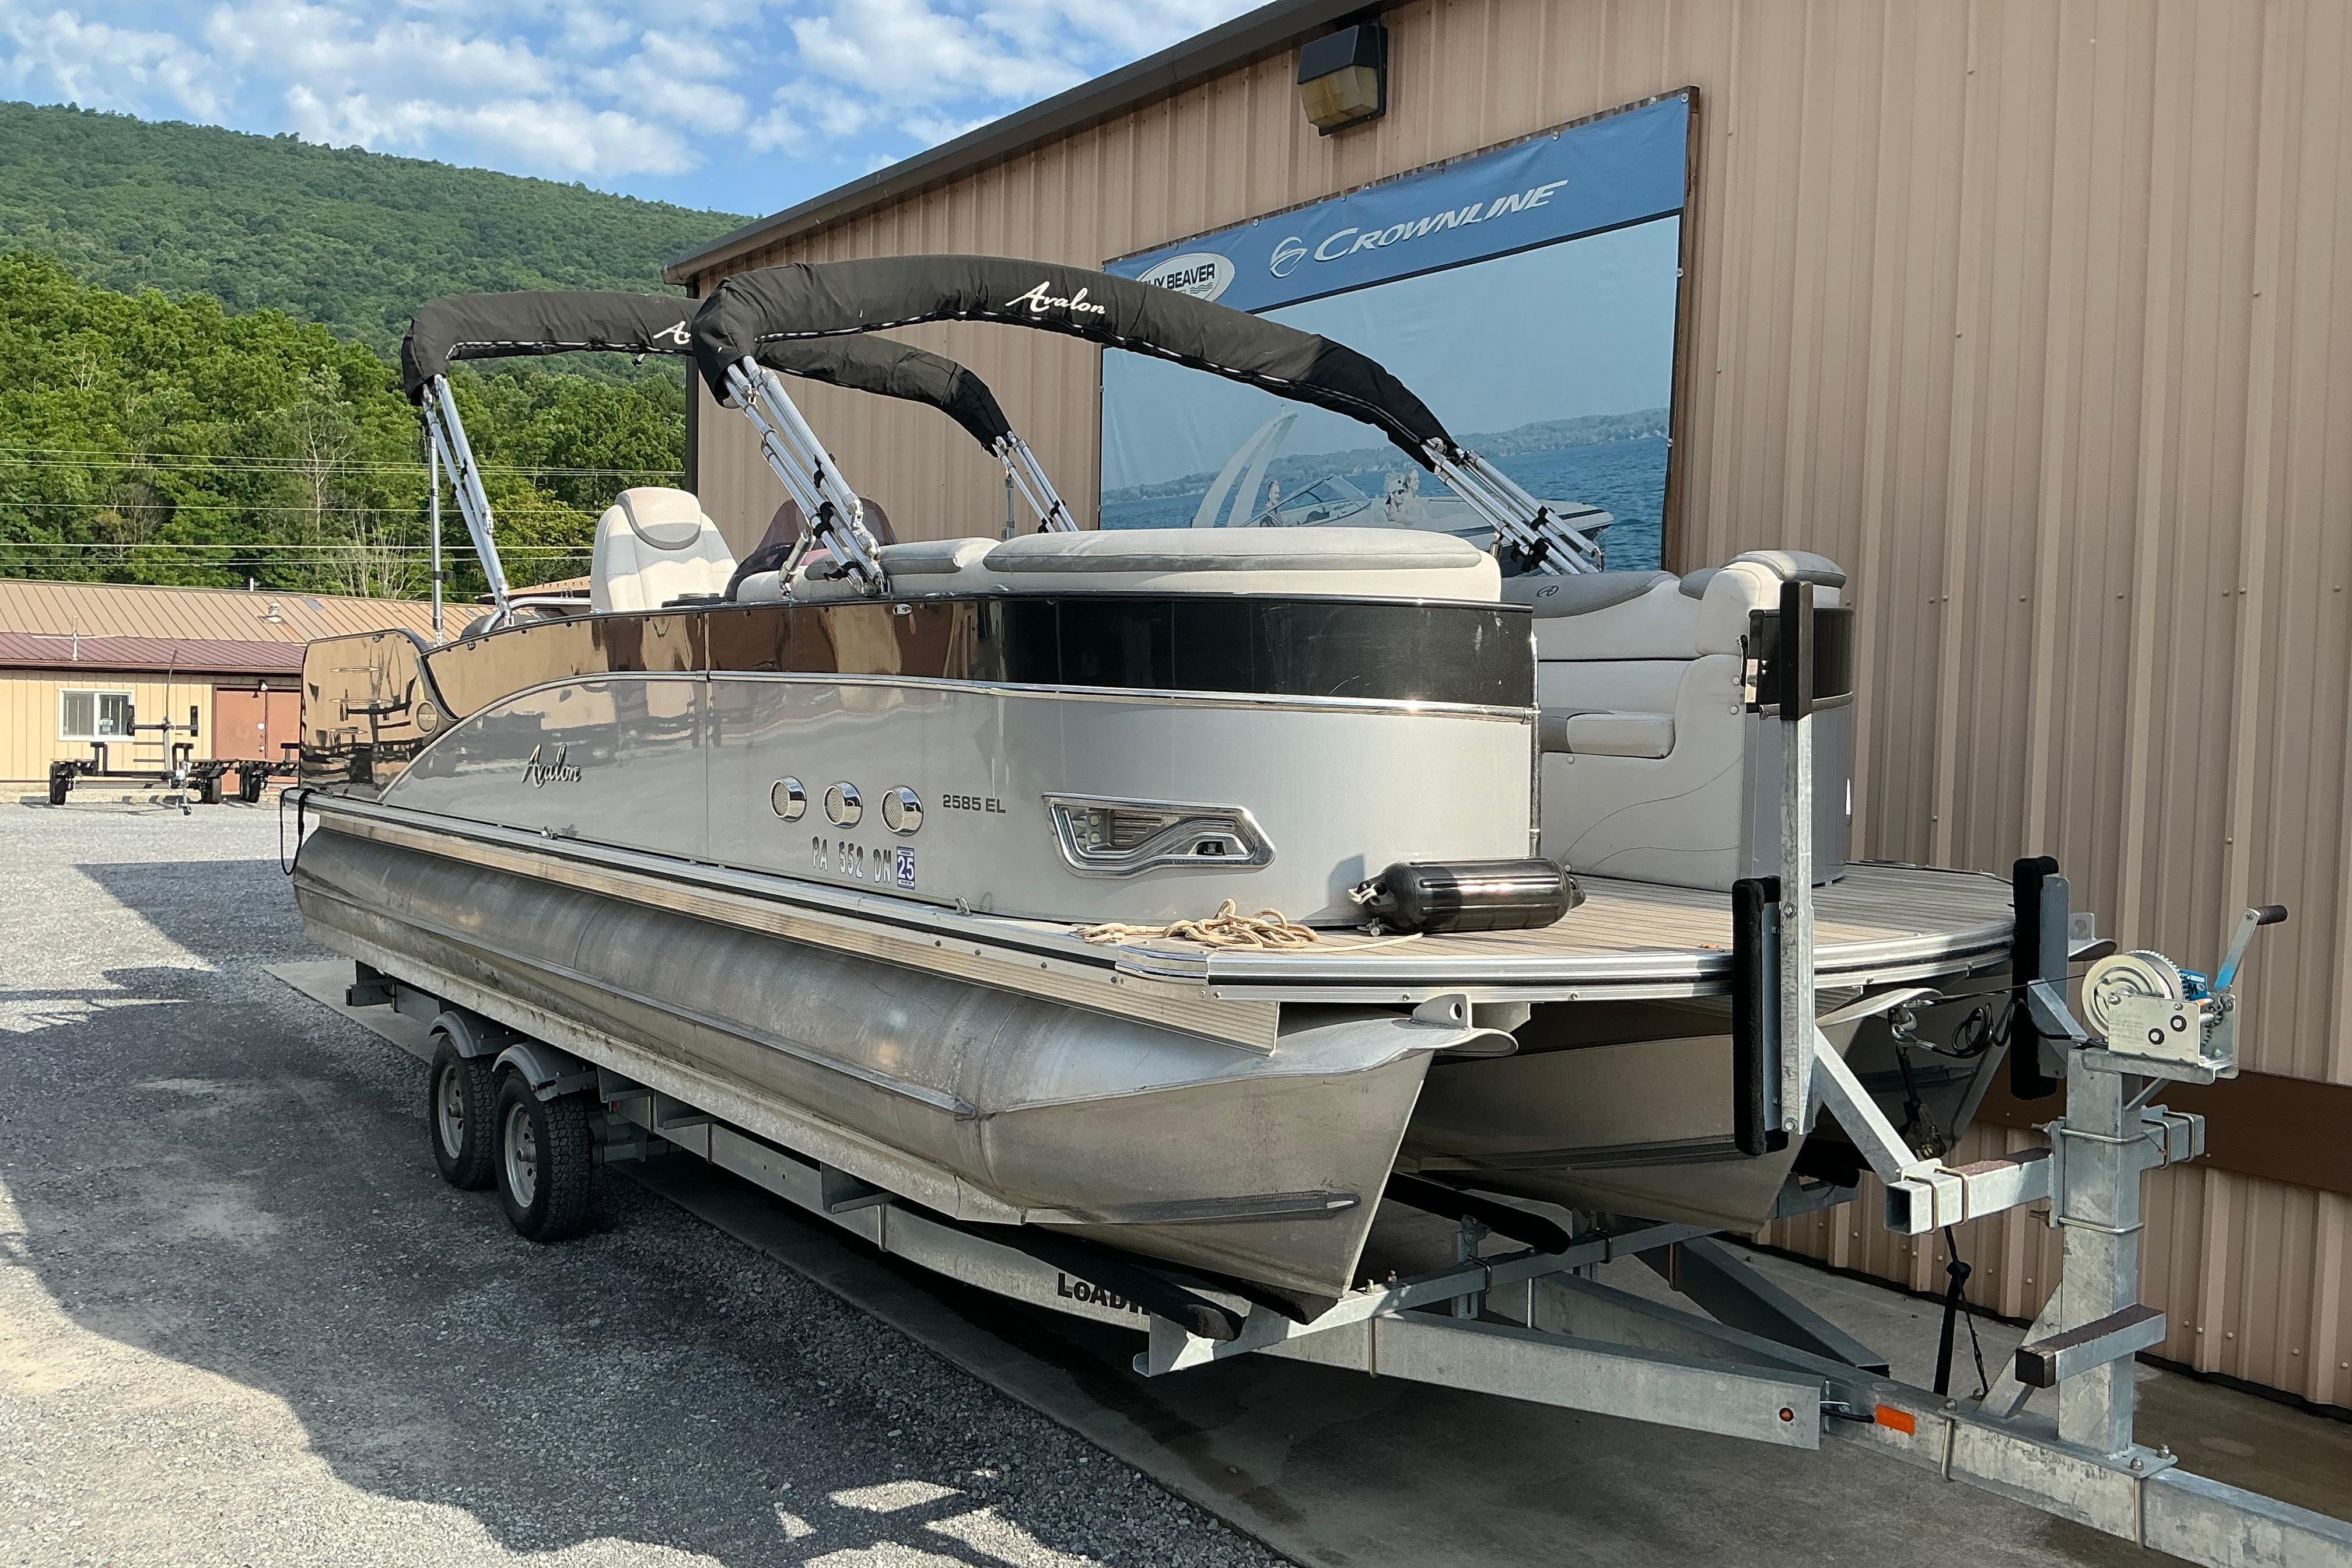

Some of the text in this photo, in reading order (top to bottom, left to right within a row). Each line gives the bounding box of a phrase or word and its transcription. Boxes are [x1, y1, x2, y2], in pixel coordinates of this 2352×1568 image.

[1314, 180, 1568, 261] CROWNLINE
[1167, 263, 1214, 289] BEAVER
[1005, 281, 1105, 314] Avalon
[521, 743, 582, 788] Avalon
[943, 794, 1006, 813] 2585 EL
[812, 836, 828, 872] PA
[838, 841, 863, 878] 552
[897, 855, 914, 881] 25
